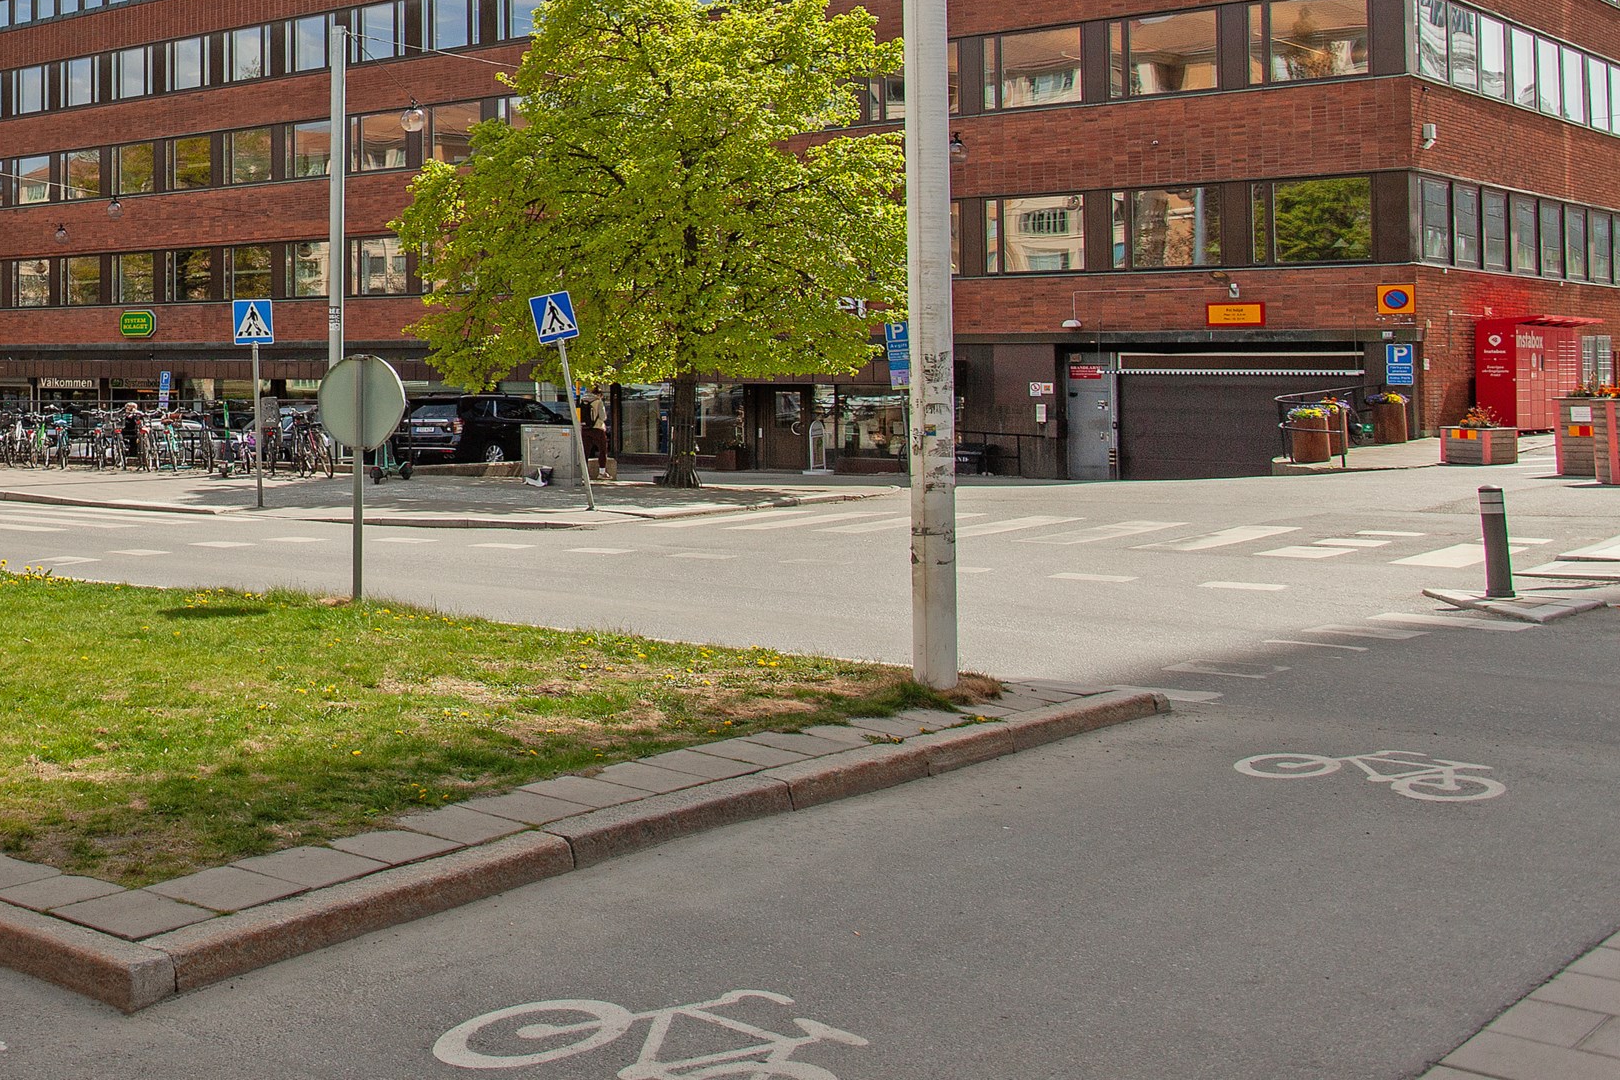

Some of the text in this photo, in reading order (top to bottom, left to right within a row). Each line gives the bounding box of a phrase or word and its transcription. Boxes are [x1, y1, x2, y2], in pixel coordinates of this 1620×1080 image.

[891, 323, 904, 339] P
[1516, 329, 1544, 349] instabox
[1393, 346, 1408, 362] P
[40, 377, 93, 388] Välkommen
